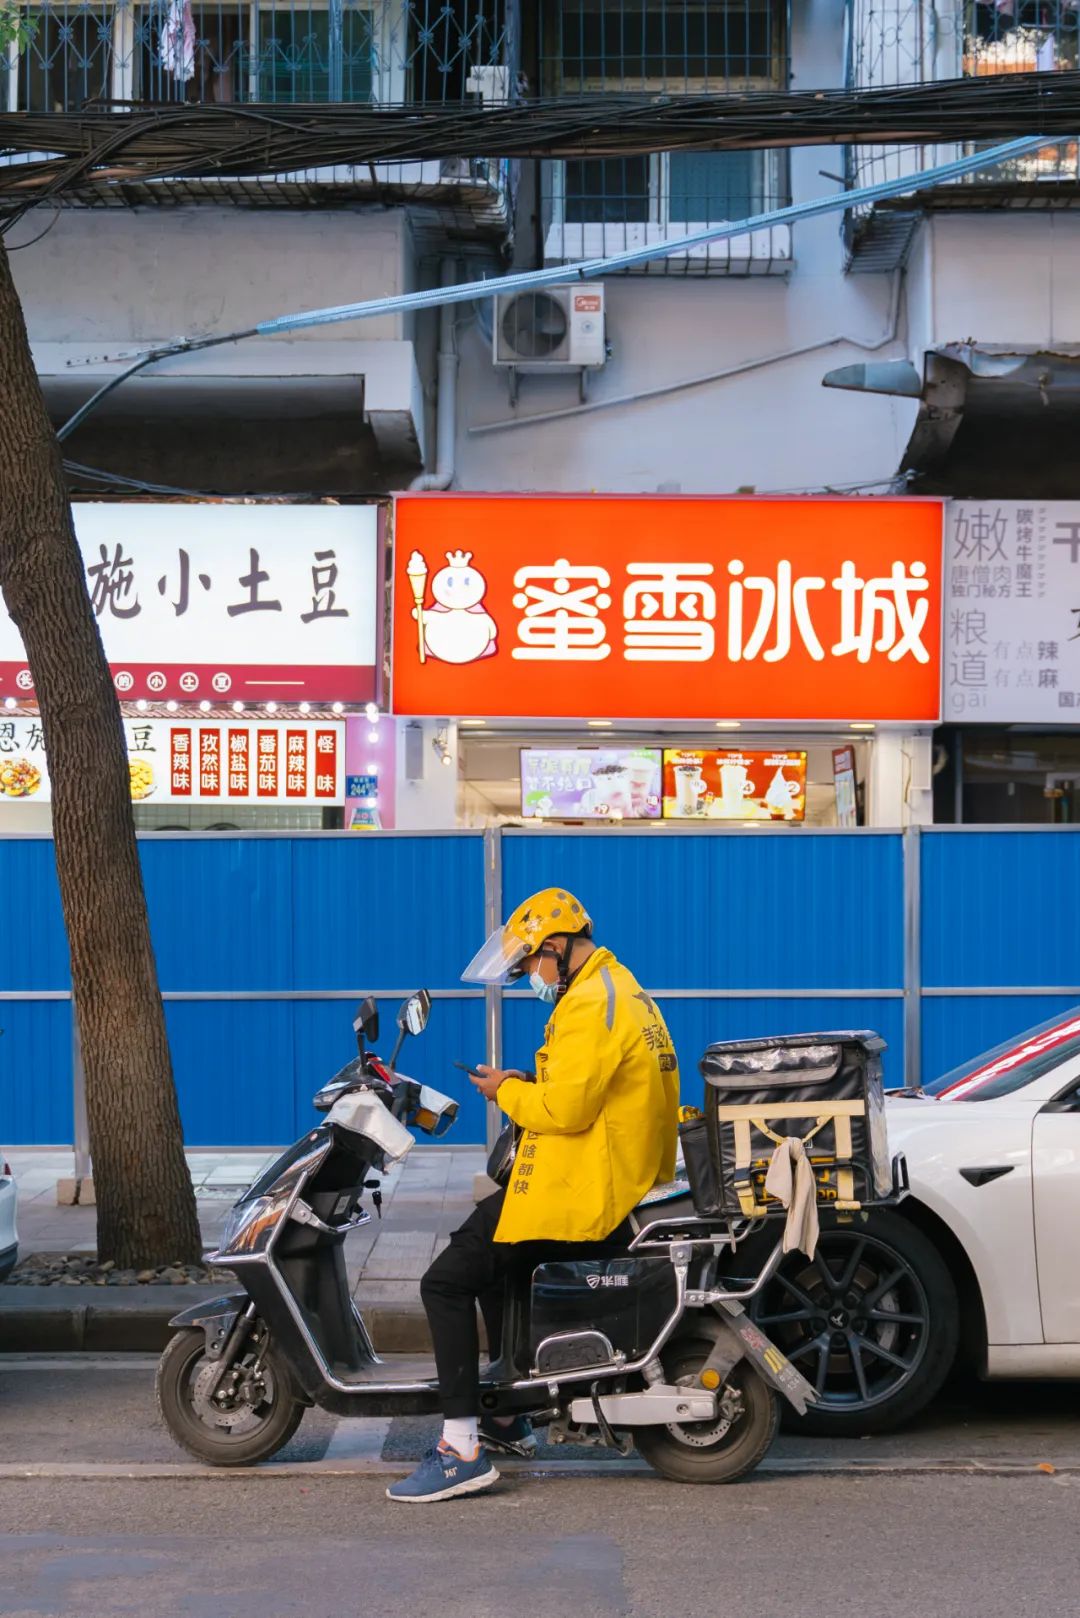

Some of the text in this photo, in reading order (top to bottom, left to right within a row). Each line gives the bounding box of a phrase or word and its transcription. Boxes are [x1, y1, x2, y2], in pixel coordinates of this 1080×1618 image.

[953, 508, 1008, 562] 嫩
[511, 558, 930, 664] 蜜雪冰城
[172, 734, 191, 789] 香辣味
[201, 734, 219, 789] 孜然味
[230, 735, 248, 790] 椒盐味
[259, 735, 277, 790] 番茄味
[287, 735, 306, 790] 麻辣味
